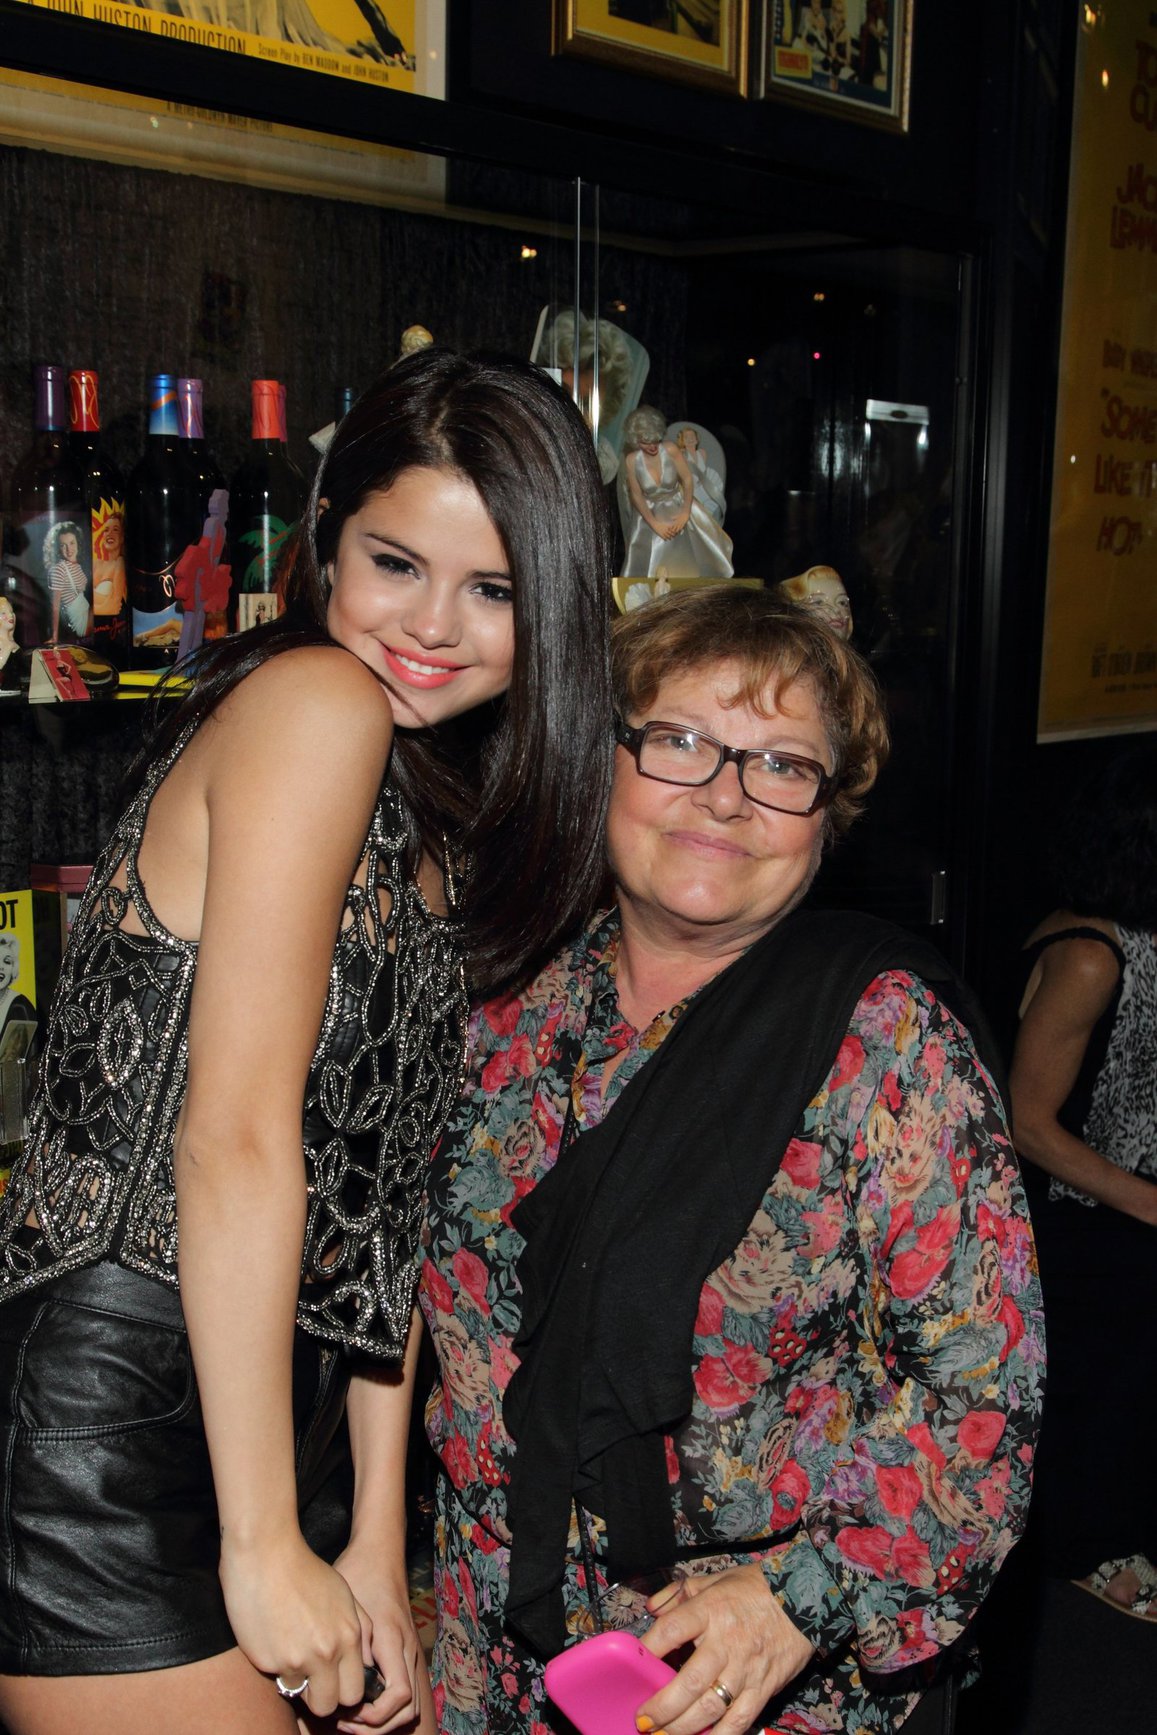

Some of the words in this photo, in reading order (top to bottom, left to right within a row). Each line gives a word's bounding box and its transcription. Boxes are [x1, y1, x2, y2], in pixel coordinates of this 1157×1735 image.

[93, 3, 151, 33] HUSTON
[160, 19, 246, 54] PRODUCTION
[258, 42, 278, 58] Screen
